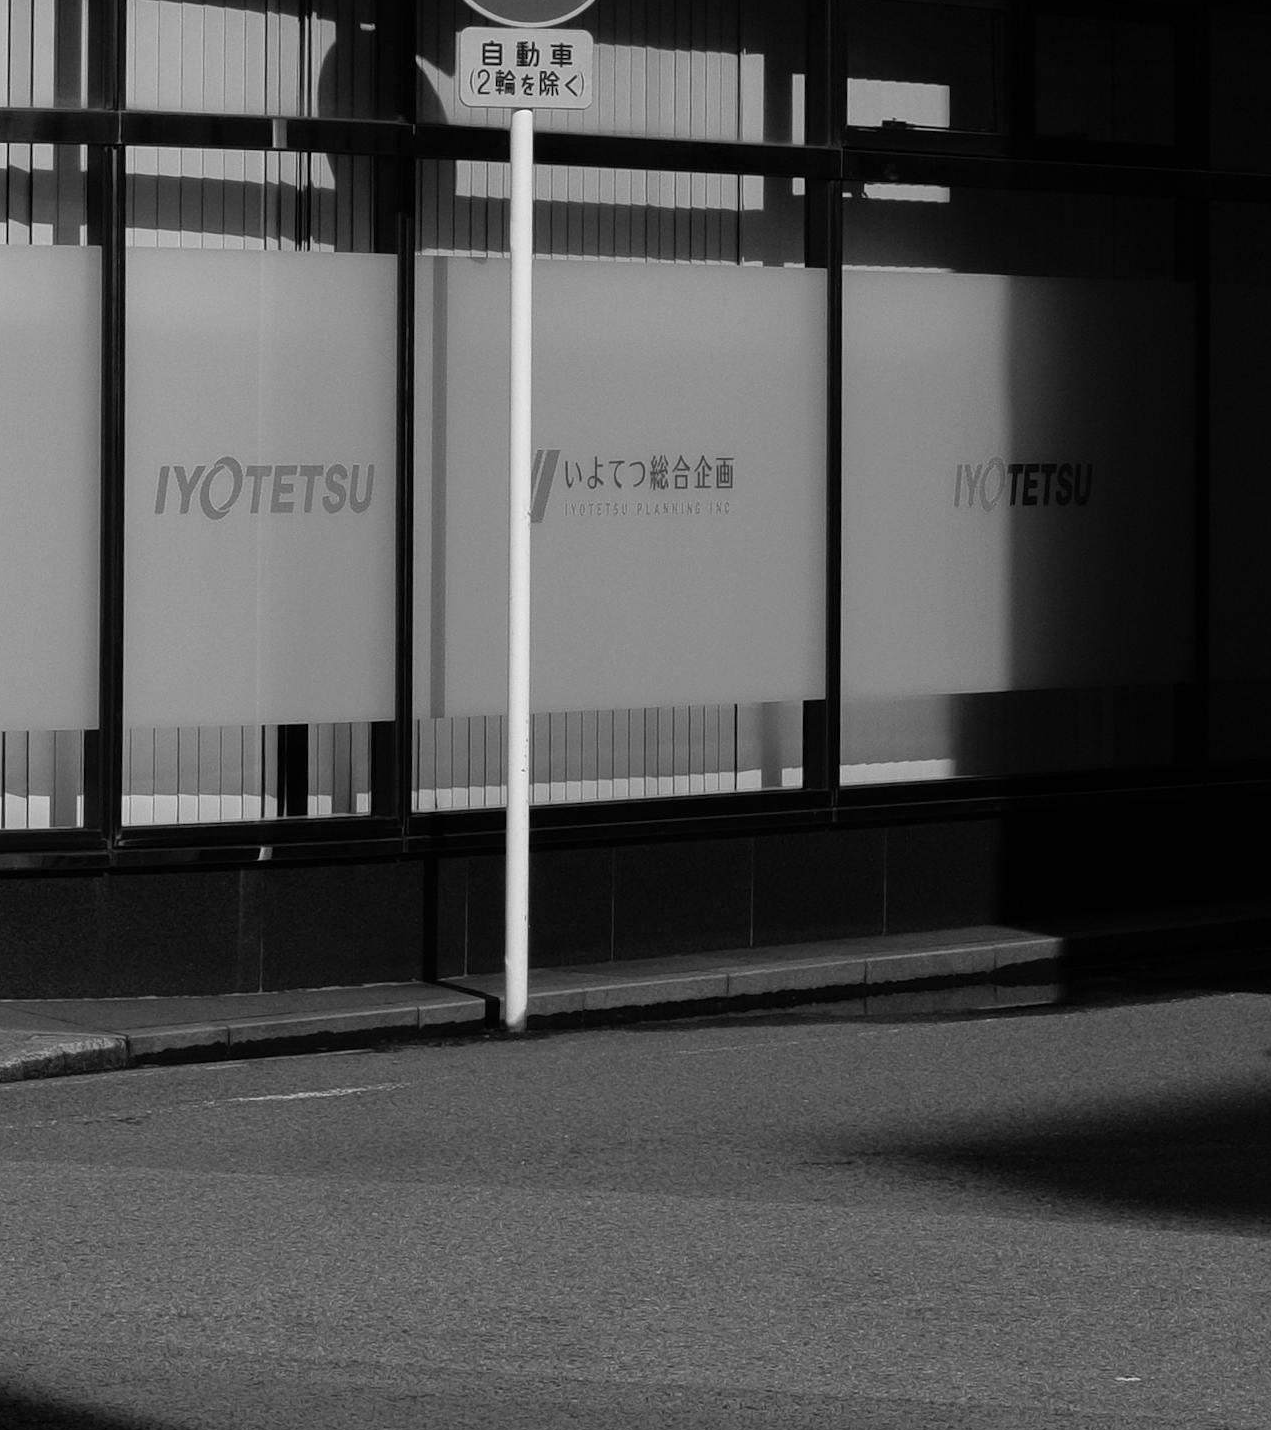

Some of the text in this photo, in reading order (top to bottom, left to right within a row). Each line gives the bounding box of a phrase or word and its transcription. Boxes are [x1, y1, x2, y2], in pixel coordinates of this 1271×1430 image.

[481, 40, 574, 69] 自動車
[154, 456, 375, 520] IYOTETSU
[565, 454, 735, 490] いよてつ総合企画
[954, 456, 1093, 512] IYOTETSU
[564, 501, 628, 516] IYOTETSU
[637, 501, 701, 516] PLANNING
